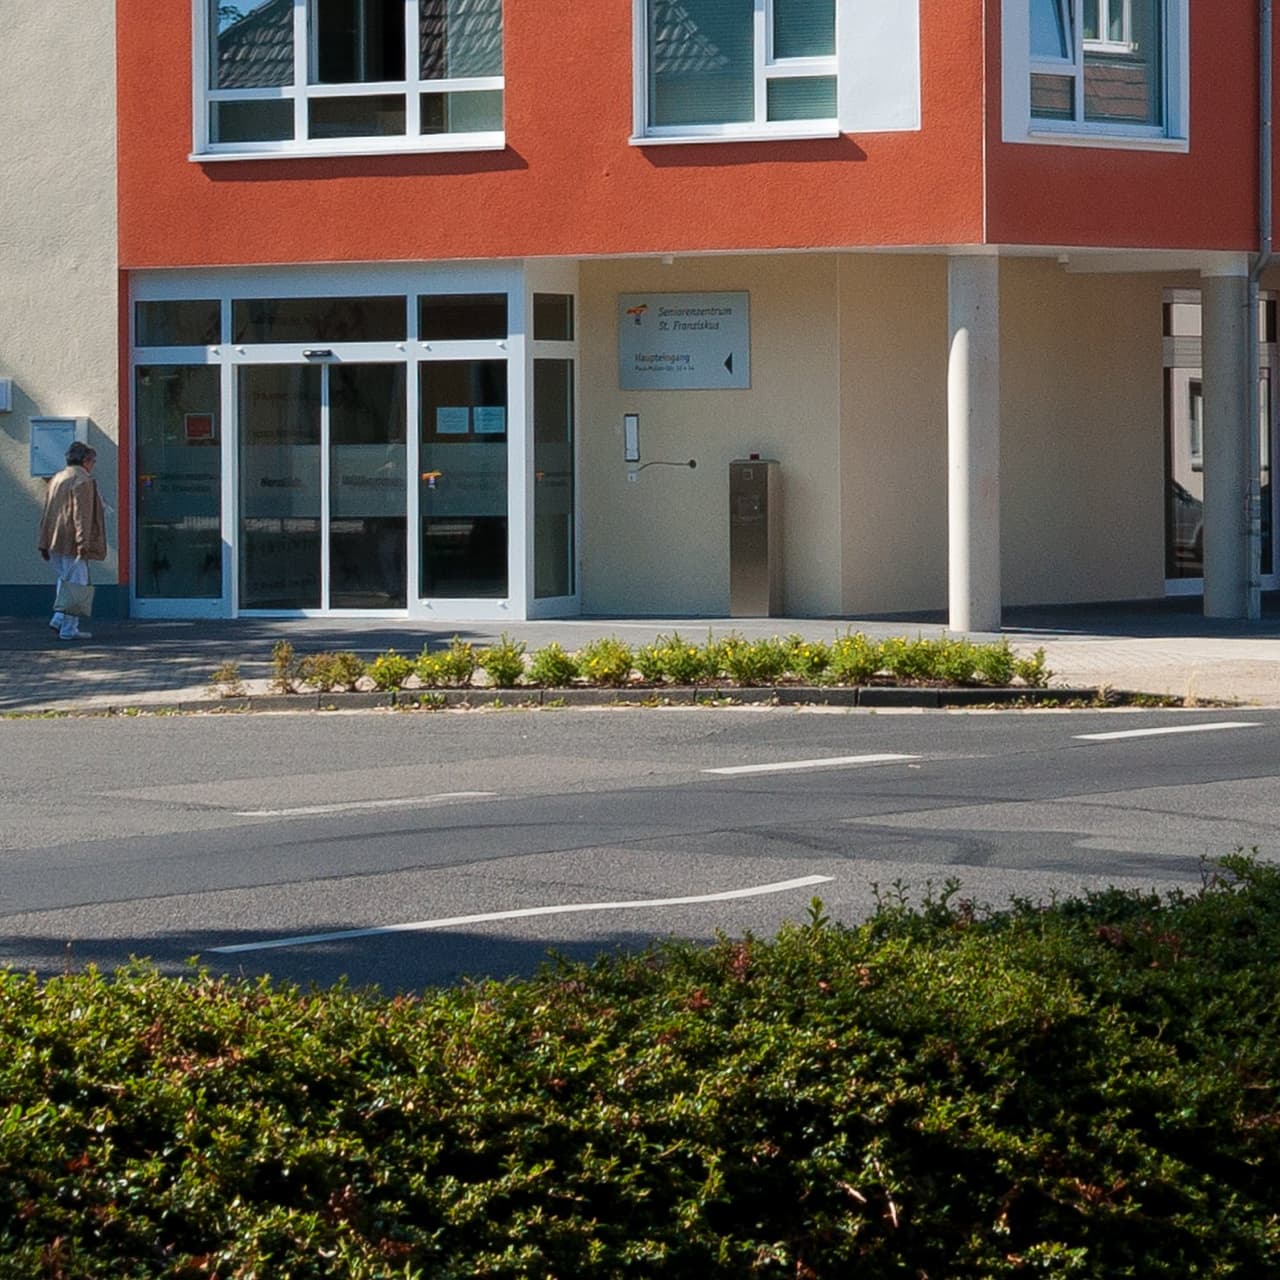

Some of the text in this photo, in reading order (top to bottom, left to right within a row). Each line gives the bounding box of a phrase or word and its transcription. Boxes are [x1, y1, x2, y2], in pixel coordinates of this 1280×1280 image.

[658, 306, 732, 317] Seniorenzentrum
[673, 320, 720, 330] Franziskus
[635, 352, 690, 363] Haupteingang
